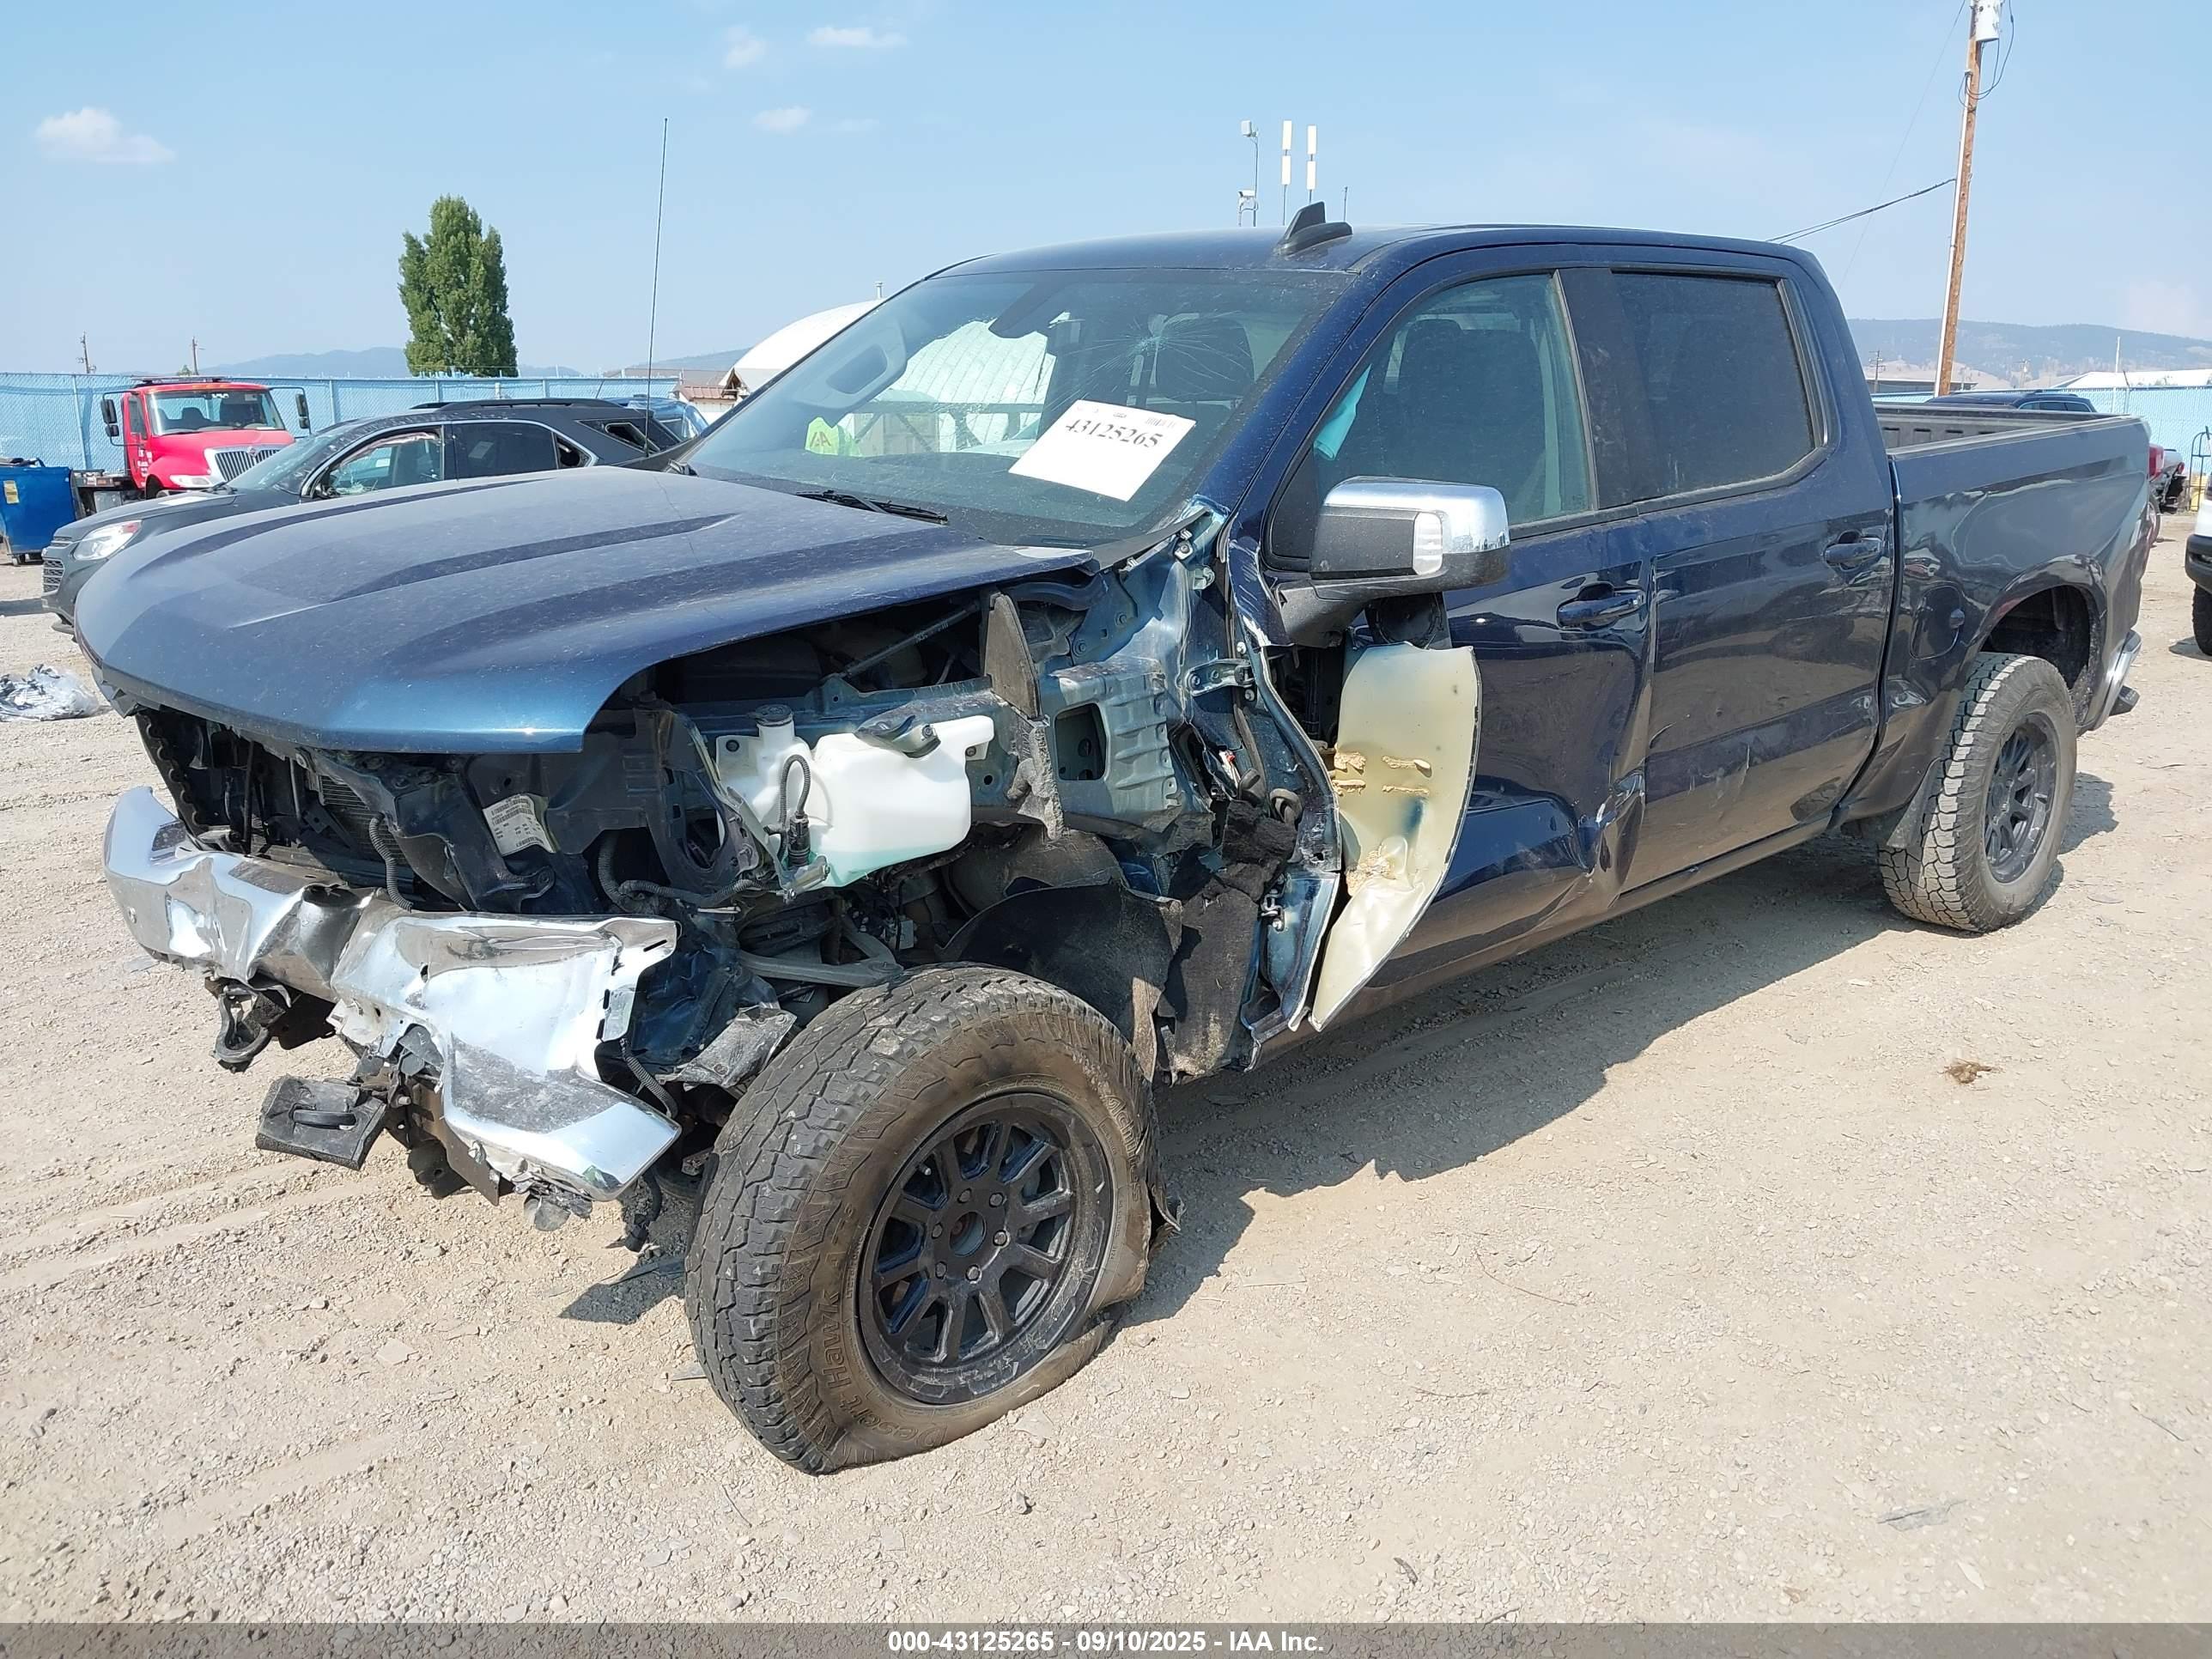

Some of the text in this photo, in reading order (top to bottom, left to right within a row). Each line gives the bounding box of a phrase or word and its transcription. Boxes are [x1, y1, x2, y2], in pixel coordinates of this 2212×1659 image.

[1066, 418, 1164, 448] 43125265
[817, 1289, 853, 1390] Hawk
[837, 1392, 948, 1449] Desert
